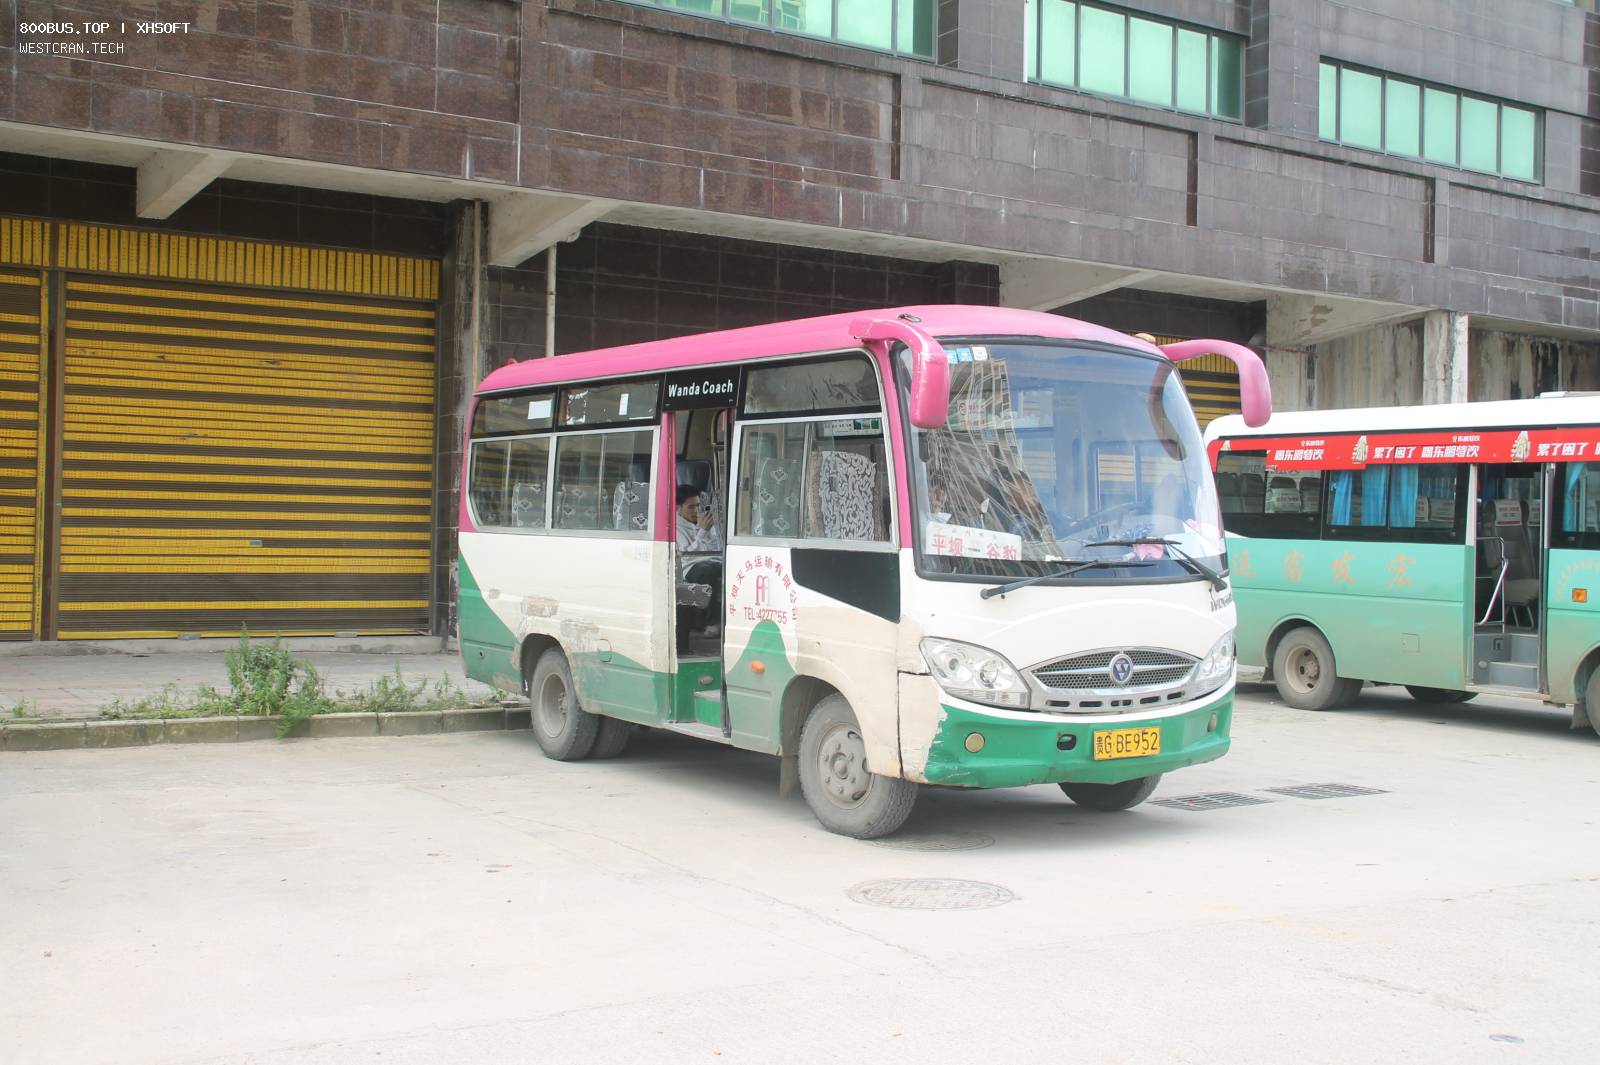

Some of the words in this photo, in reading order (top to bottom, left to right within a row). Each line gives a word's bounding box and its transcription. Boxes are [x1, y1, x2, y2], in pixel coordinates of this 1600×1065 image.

[668, 382, 700, 397] Wanda
[702, 379, 733, 394] Coach
[1373, 446, 1417, 459] 累了困了
[1421, 445, 1480, 458] 喝东鹏特饮
[1536, 442, 1590, 456] 累了困了
